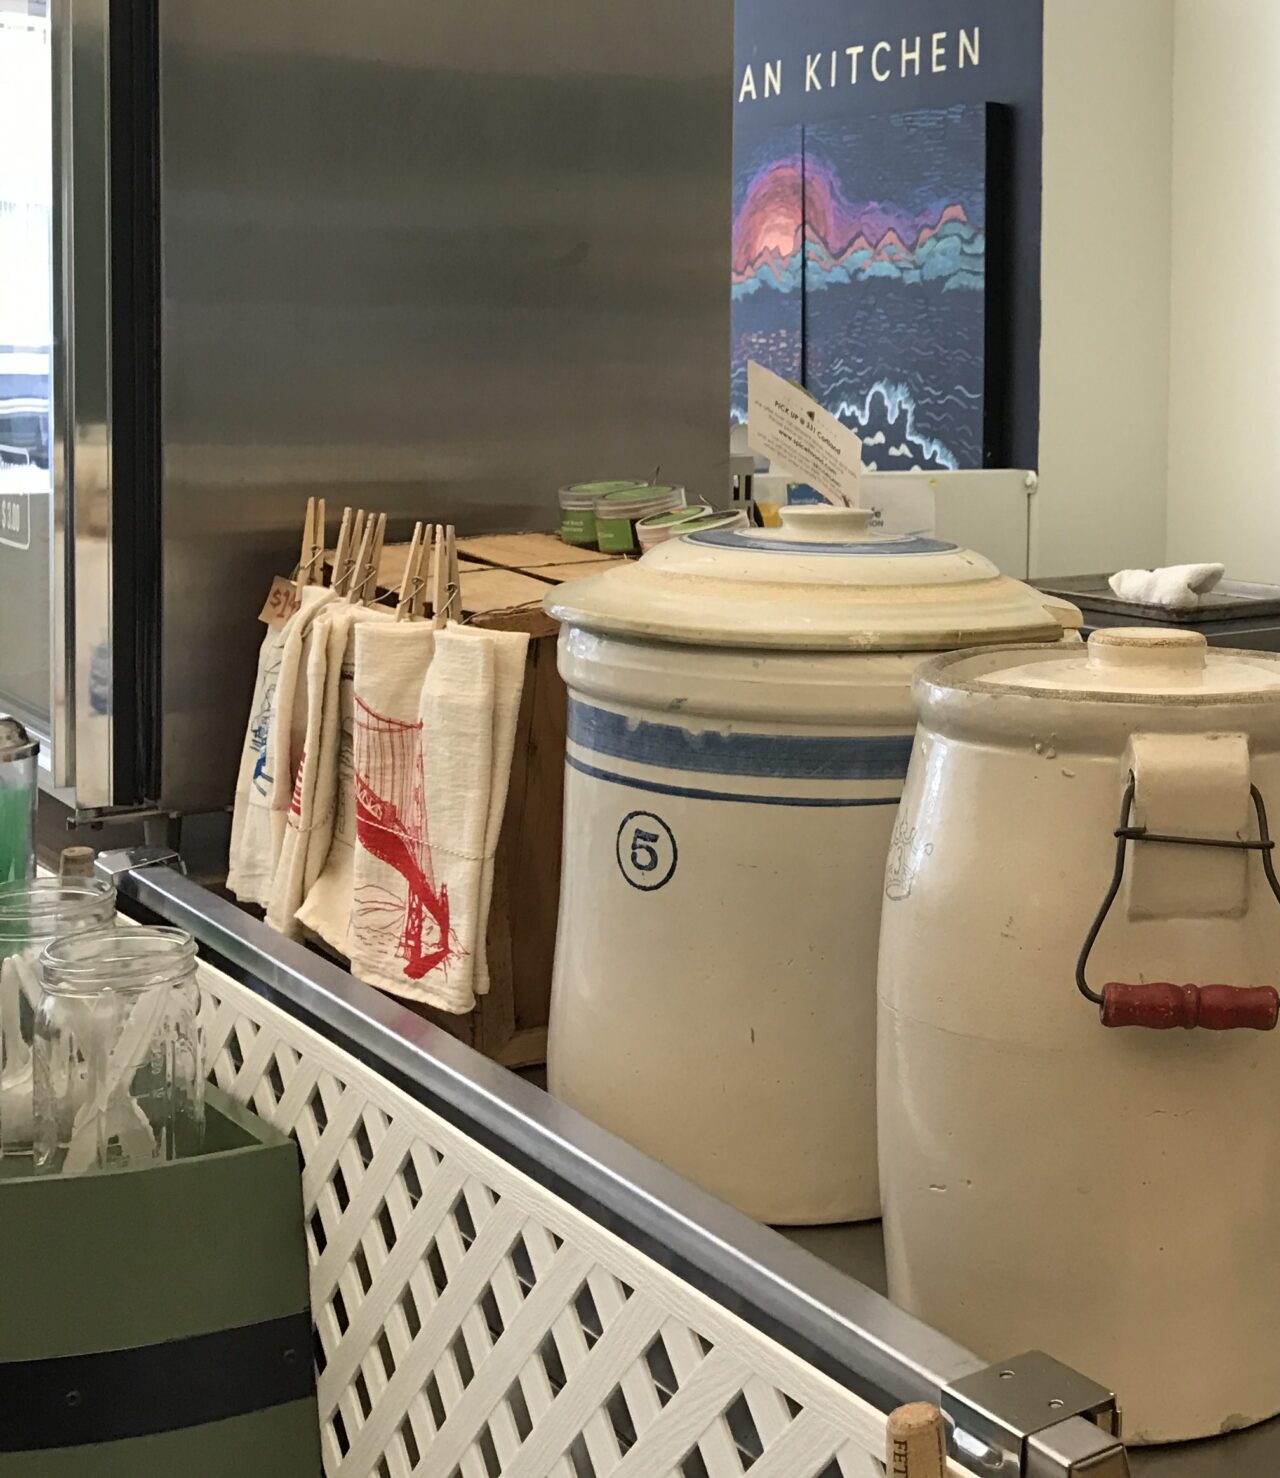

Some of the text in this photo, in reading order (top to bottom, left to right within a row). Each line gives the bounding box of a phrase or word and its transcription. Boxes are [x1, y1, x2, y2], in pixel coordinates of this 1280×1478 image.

[738, 26, 980, 103] AN KITCHEN
[631, 827, 659, 872] 5
